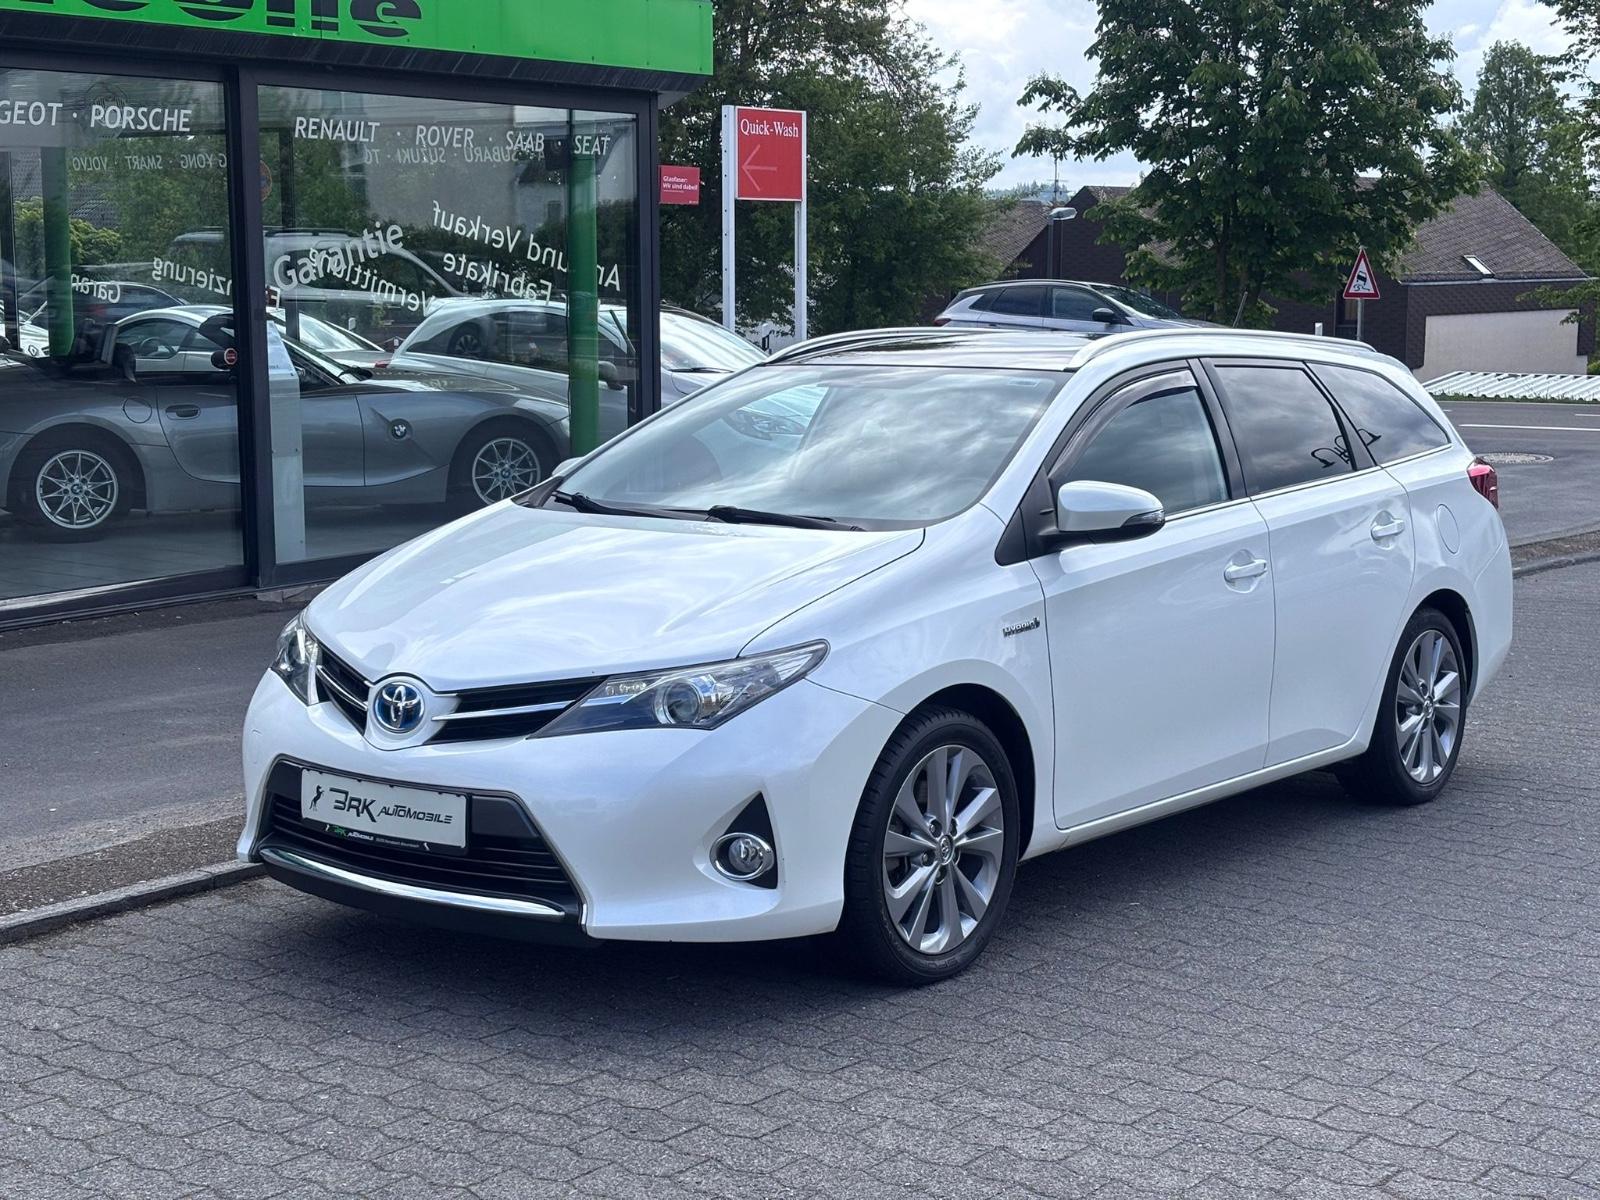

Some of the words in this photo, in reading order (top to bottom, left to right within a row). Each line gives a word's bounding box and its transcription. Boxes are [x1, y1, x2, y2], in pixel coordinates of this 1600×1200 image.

[90, 105, 192, 132] PORSCHE
[740, 118, 799, 137] Quick-Wash
[294, 116, 380, 143] RENAULT
[415, 125, 474, 148] ROVER
[506, 131, 545, 152] SAAB
[574, 135, 611, 156] SEAT
[273, 221, 404, 290] Garantie
